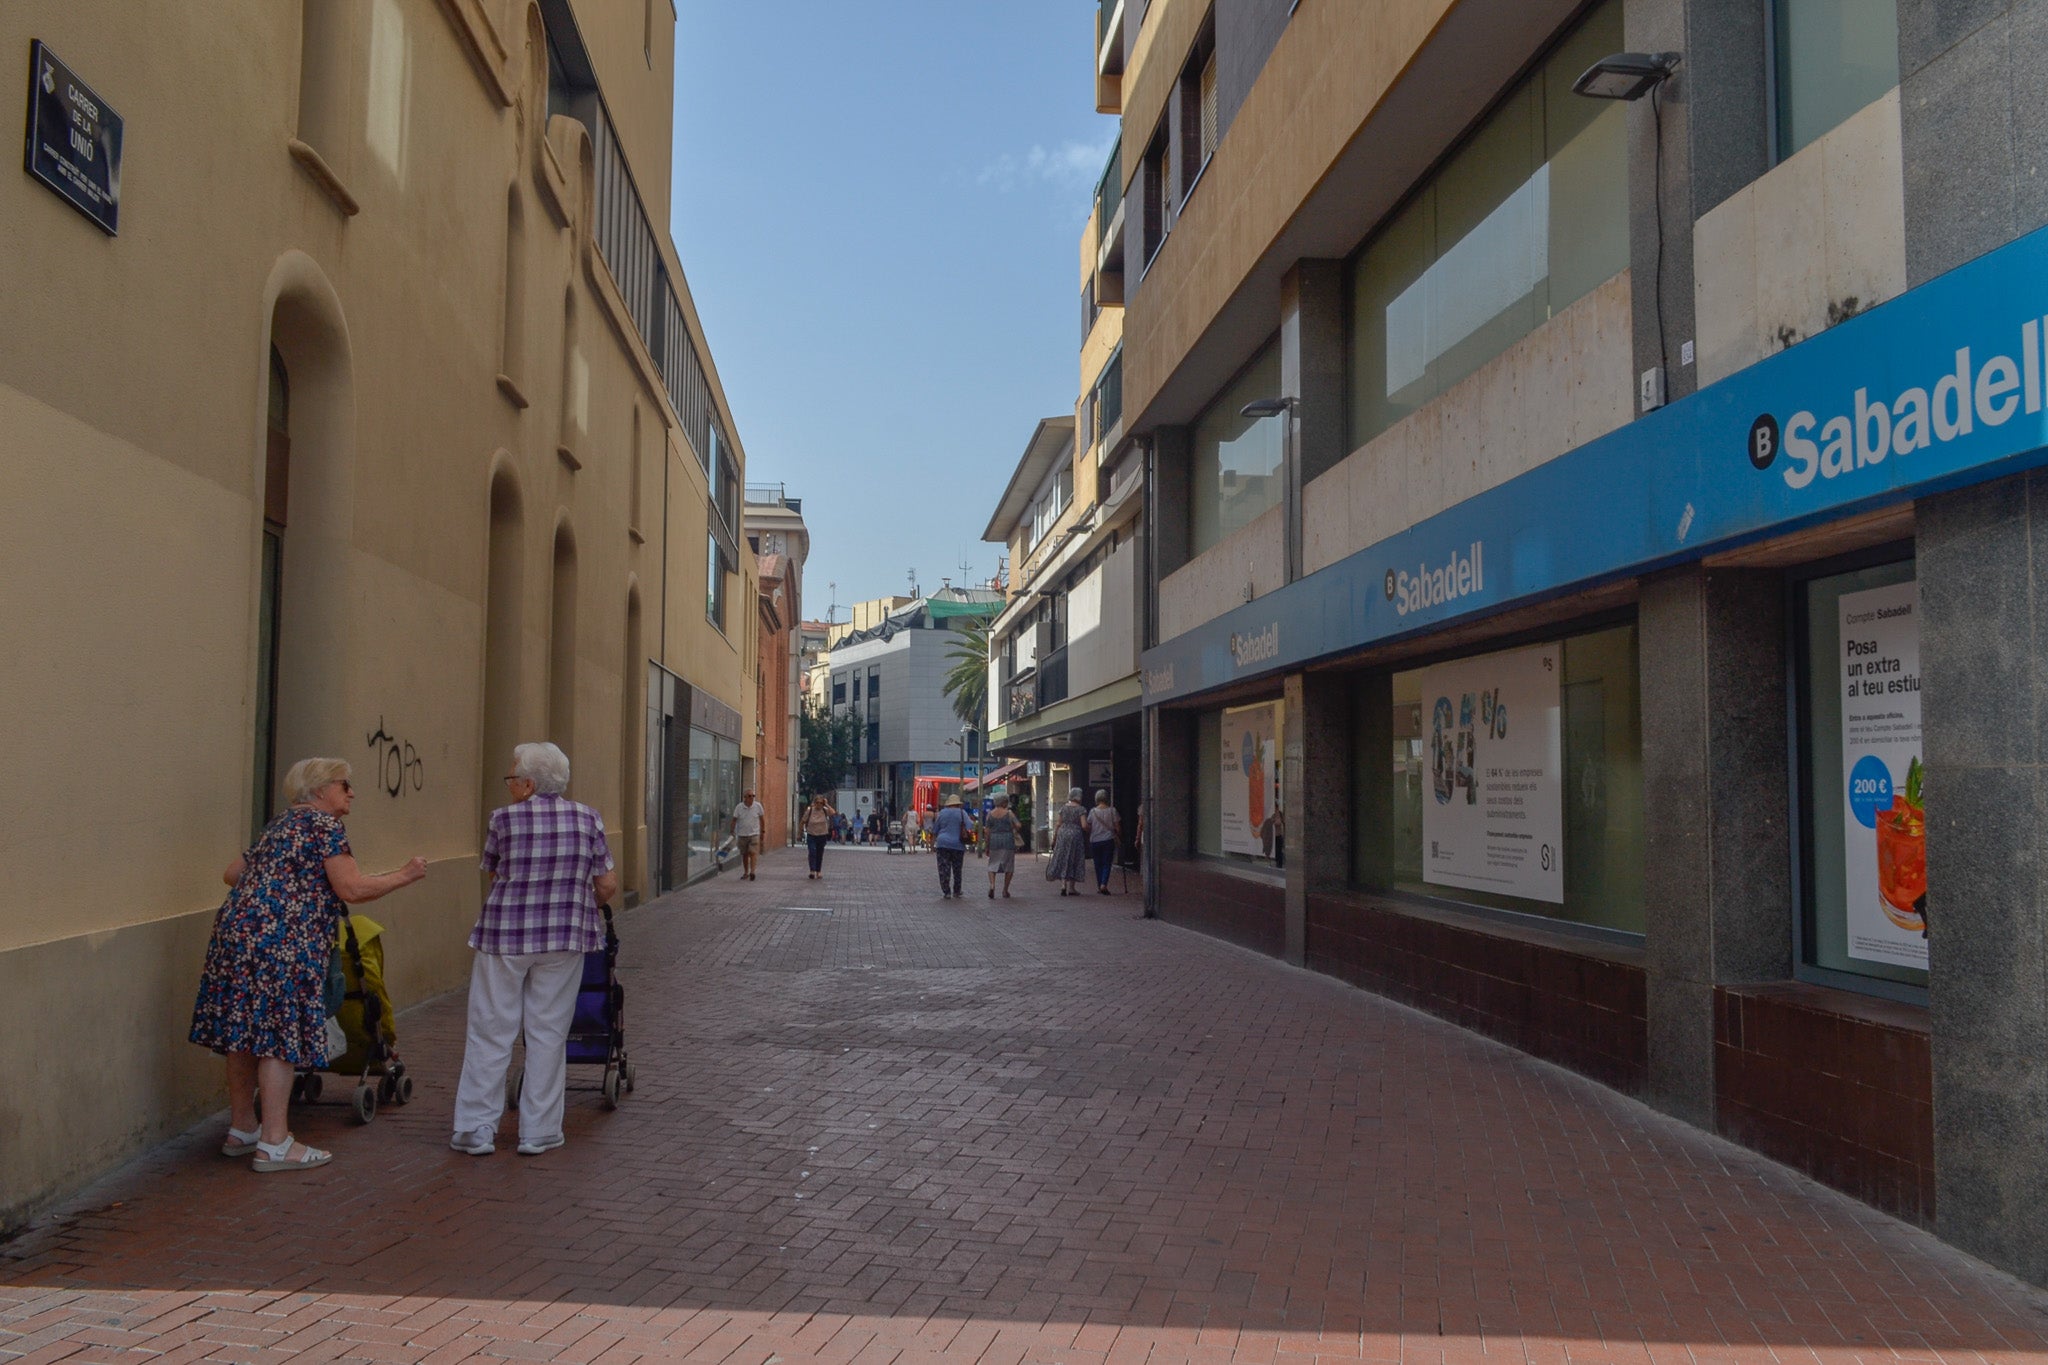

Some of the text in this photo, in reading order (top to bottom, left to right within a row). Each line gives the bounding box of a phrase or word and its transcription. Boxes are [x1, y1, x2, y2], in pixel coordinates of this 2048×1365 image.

[68, 83, 99, 122] CARRER
[73, 109, 92, 135] DE LA
[70, 127, 93, 162] UNIÓ
[1396, 541, 1483, 616] Sabadell
[1877, 604, 1912, 620] Sabadell
[1236, 621, 1279, 667] Sabadell
[1847, 640, 1877, 657] Posa
[1848, 657, 1900, 677] un extra
[1848, 674, 1920, 697] al teu estiu
[1854, 779, 1887, 794] 200 €
